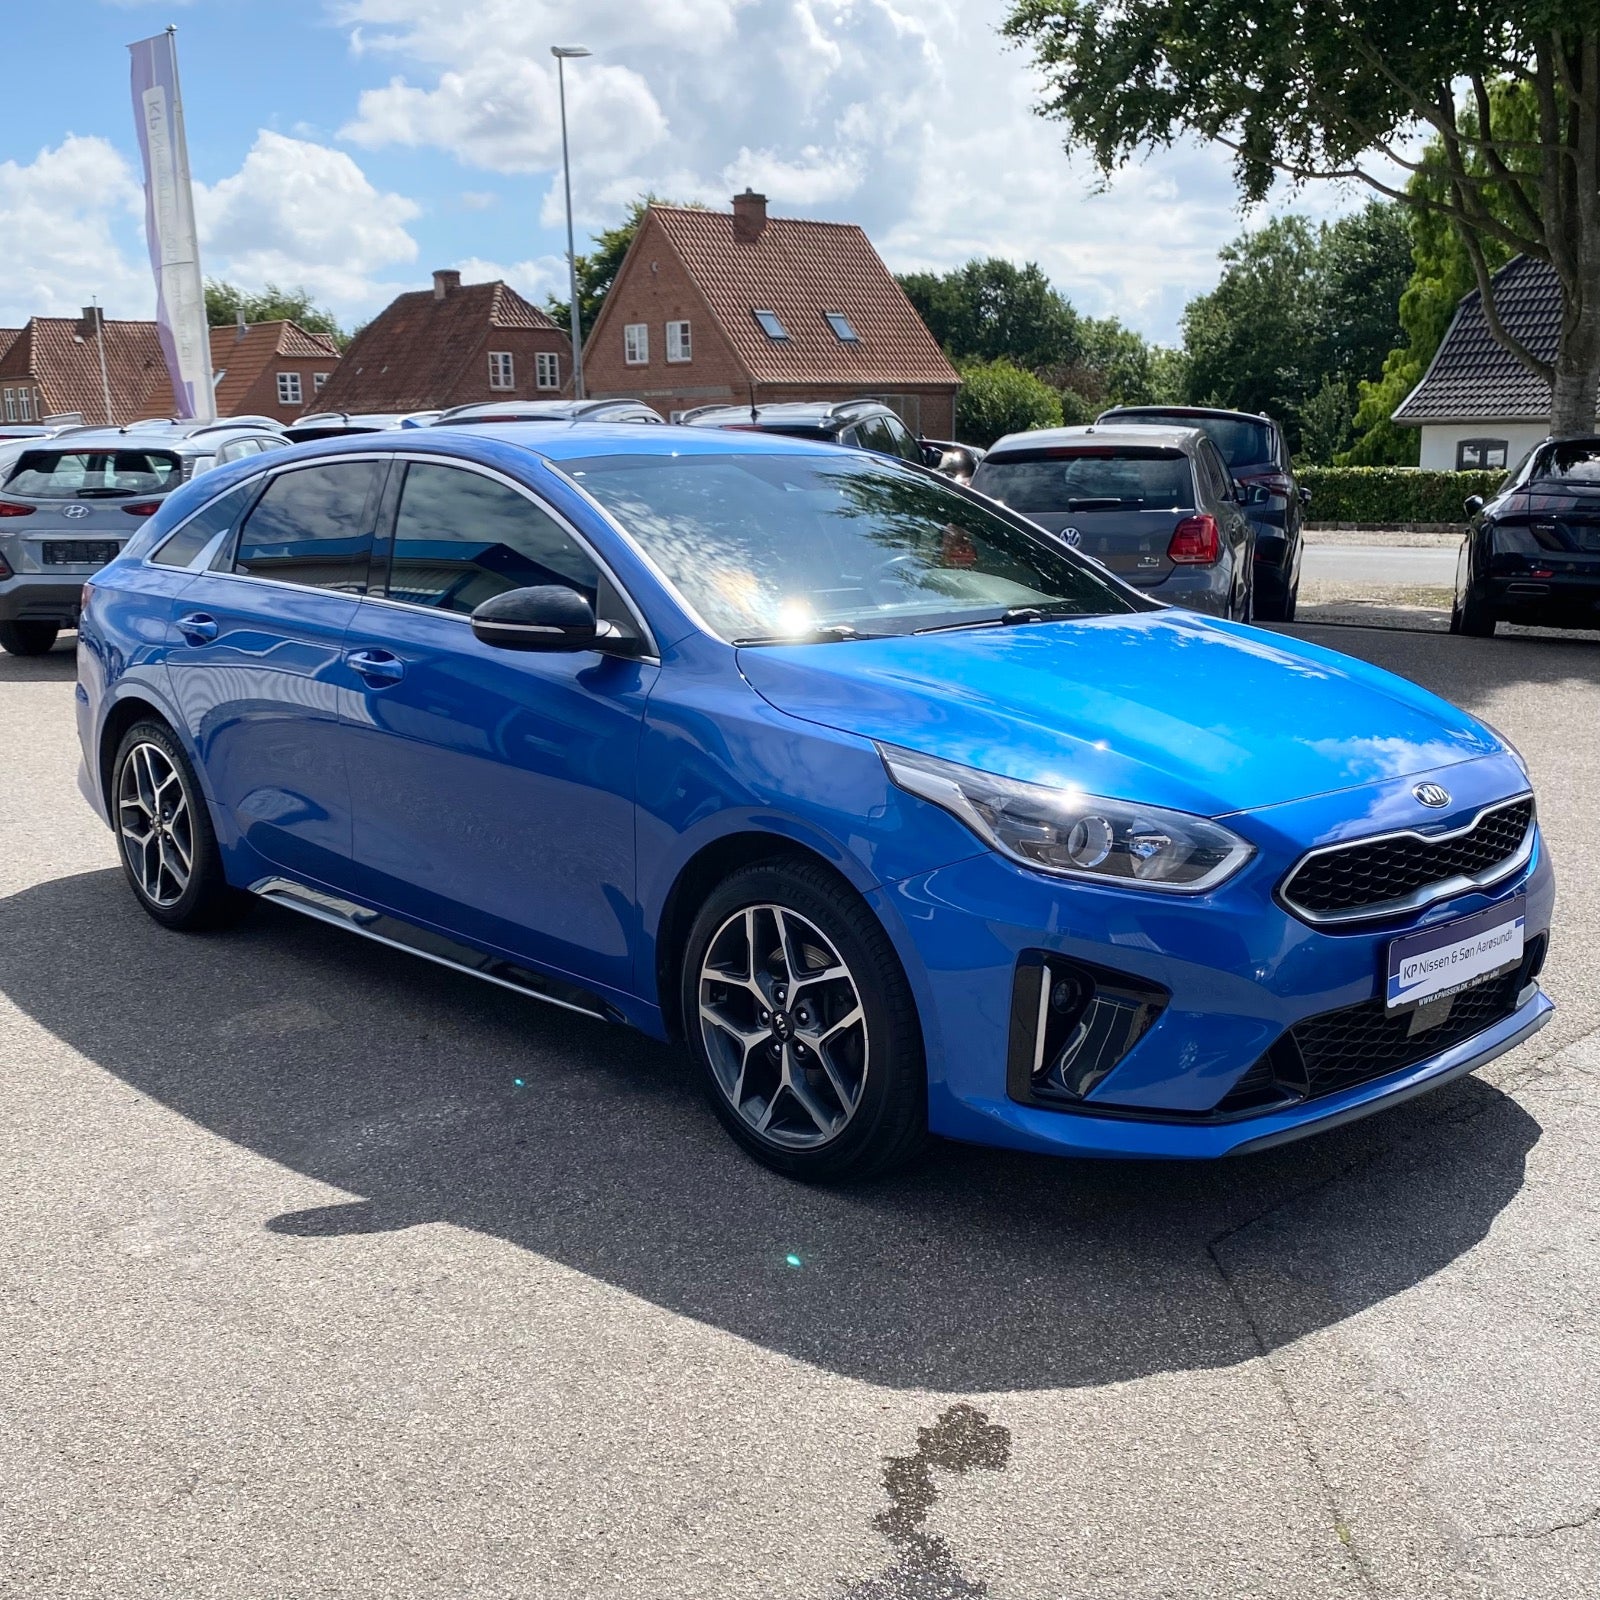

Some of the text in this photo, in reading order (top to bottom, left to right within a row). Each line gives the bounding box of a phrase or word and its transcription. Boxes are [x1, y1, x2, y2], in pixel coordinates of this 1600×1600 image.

[1416, 784, 1449, 803] KIA
[1403, 964, 1418, 980] KP
[1418, 957, 1450, 975] Nissen
[1451, 951, 1458, 964] &
[1459, 947, 1475, 961] Søn
[775, 1013, 788, 1039] KIA
